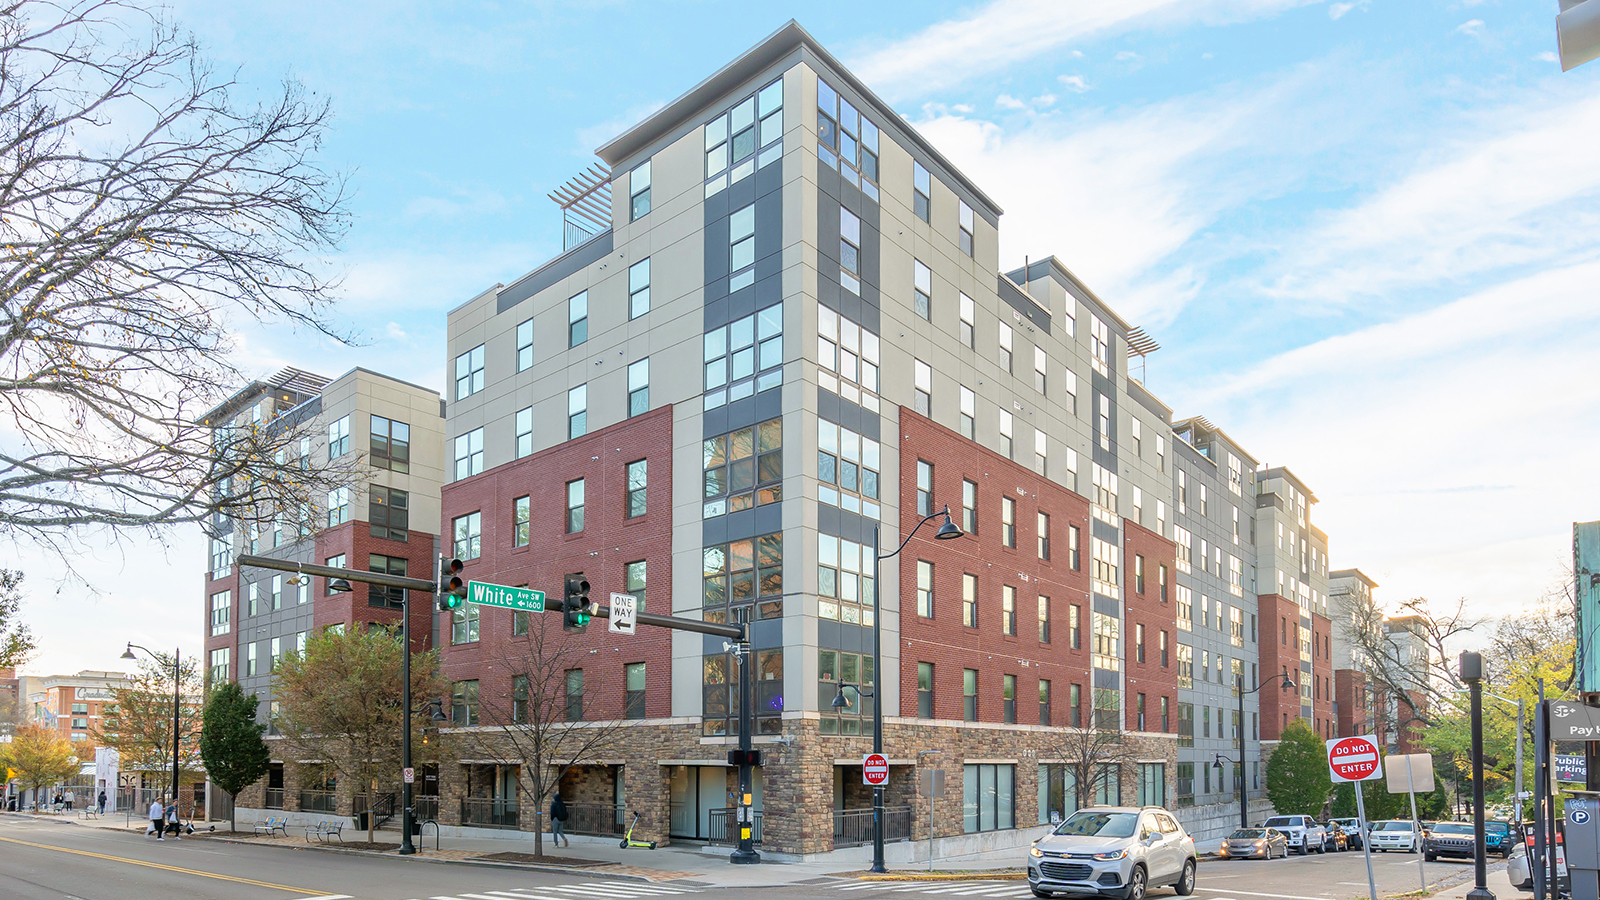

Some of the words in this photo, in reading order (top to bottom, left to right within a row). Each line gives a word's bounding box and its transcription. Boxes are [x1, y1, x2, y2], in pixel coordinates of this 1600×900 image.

[474, 585, 513, 605] White
[517, 591, 529, 599] Ave
[530, 593, 540, 601] SW
[526, 601, 541, 609] 1600
[615, 597, 632, 607] ONE
[614, 607, 632, 617] WAY
[1570, 726, 1593, 737] Pay
[1336, 746, 1349, 755] DO
[1352, 744, 1370, 753] NOT
[1341, 763, 1373, 773] ENTER
[1555, 765, 1587, 776] arking
[1575, 812, 1586, 822] P
